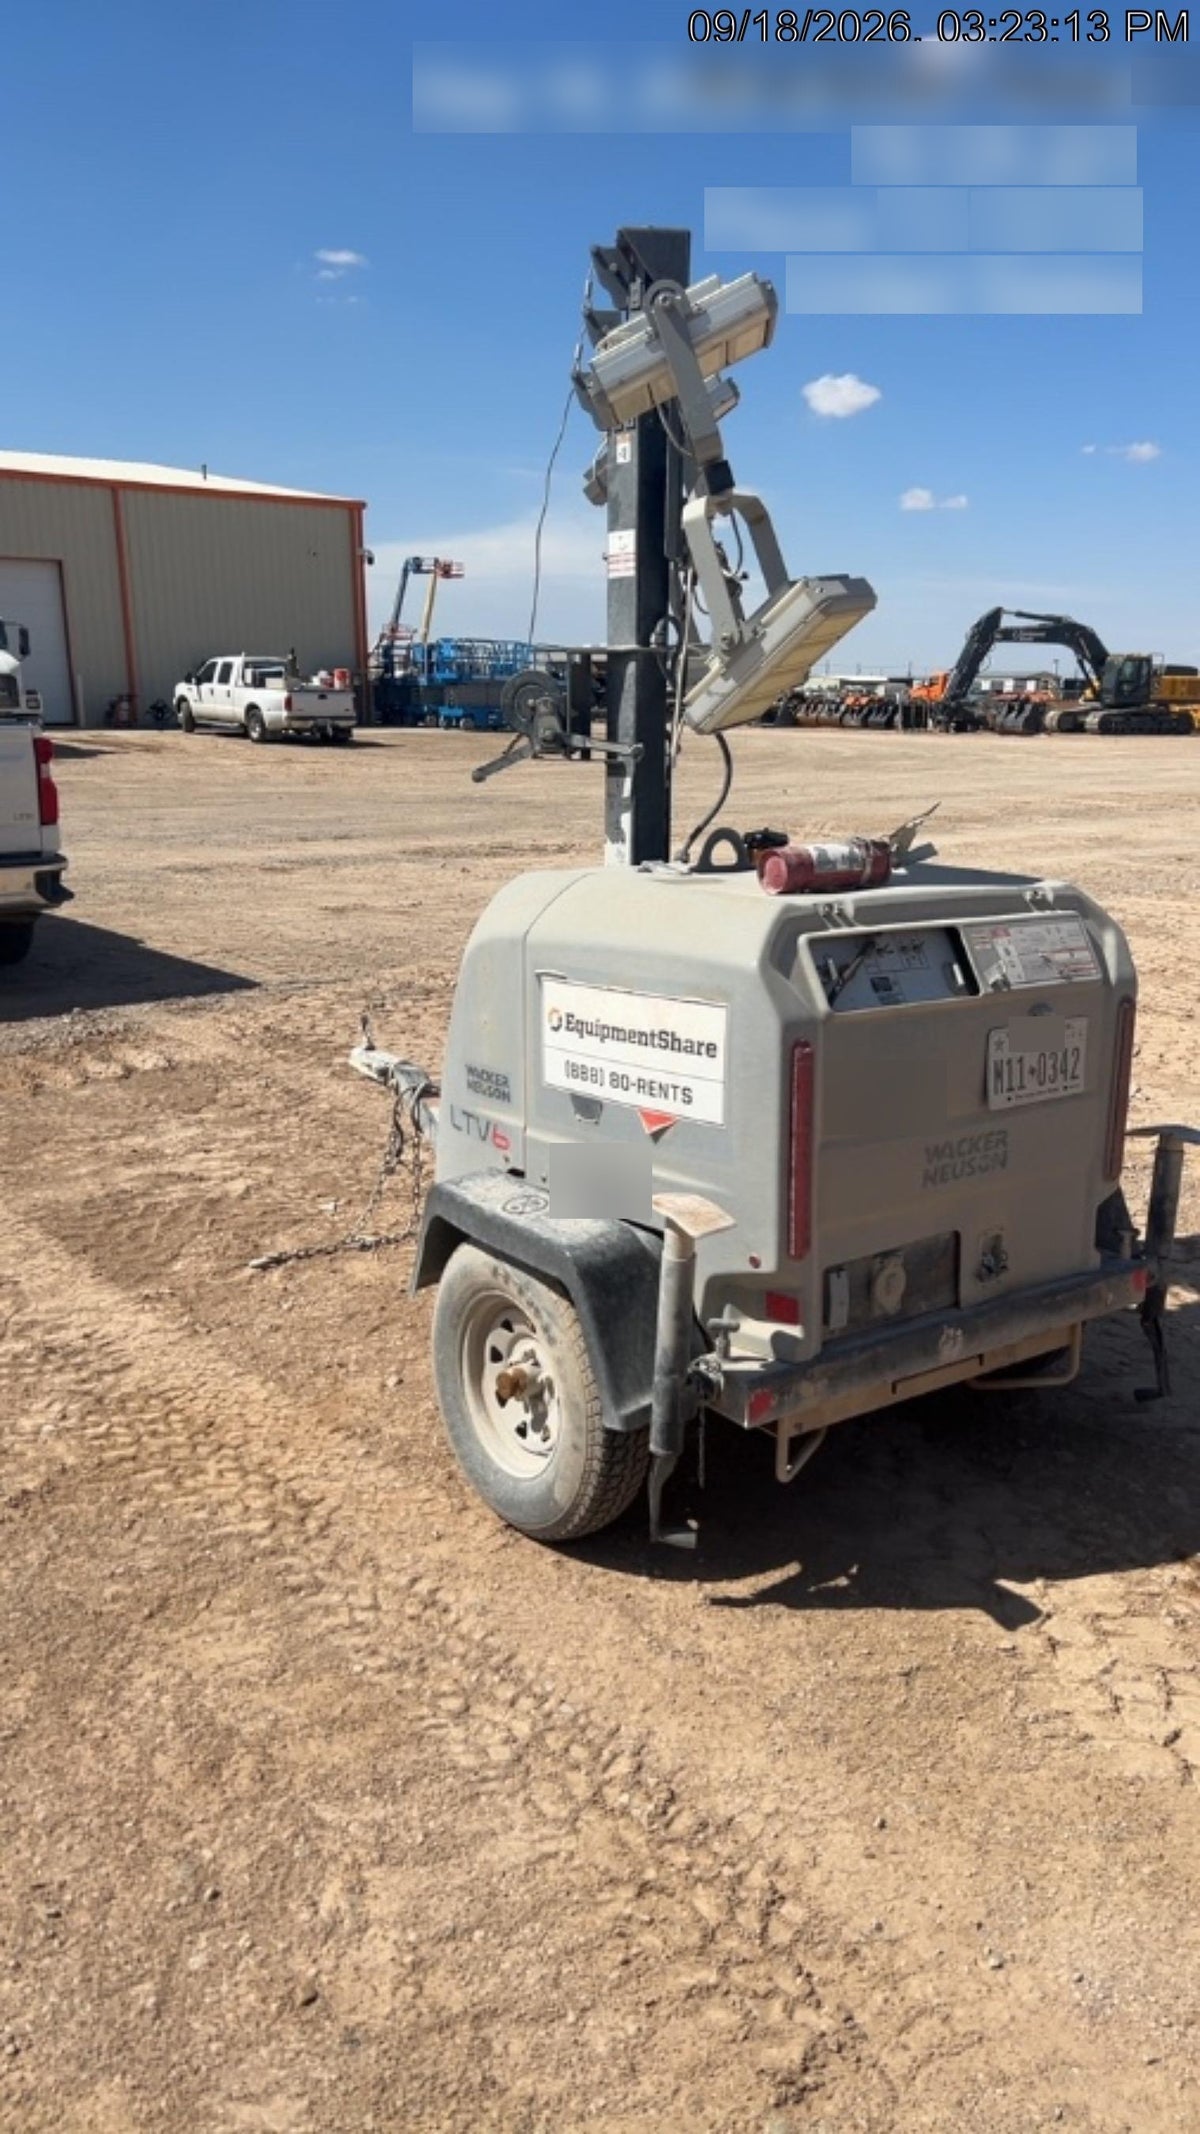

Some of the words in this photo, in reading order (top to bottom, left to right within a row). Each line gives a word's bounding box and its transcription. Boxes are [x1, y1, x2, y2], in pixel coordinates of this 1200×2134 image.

[564, 1012, 717, 1058] EquipmentShare
[464, 1064, 510, 1090] WACKER
[466, 1079, 511, 1104] NEUSON
[564, 1060, 605, 1087] (888)
[609, 1071, 693, 1105] 80-RENTS
[924, 1129, 1008, 1165] WACKER
[922, 1151, 1008, 1188] NEUSON
